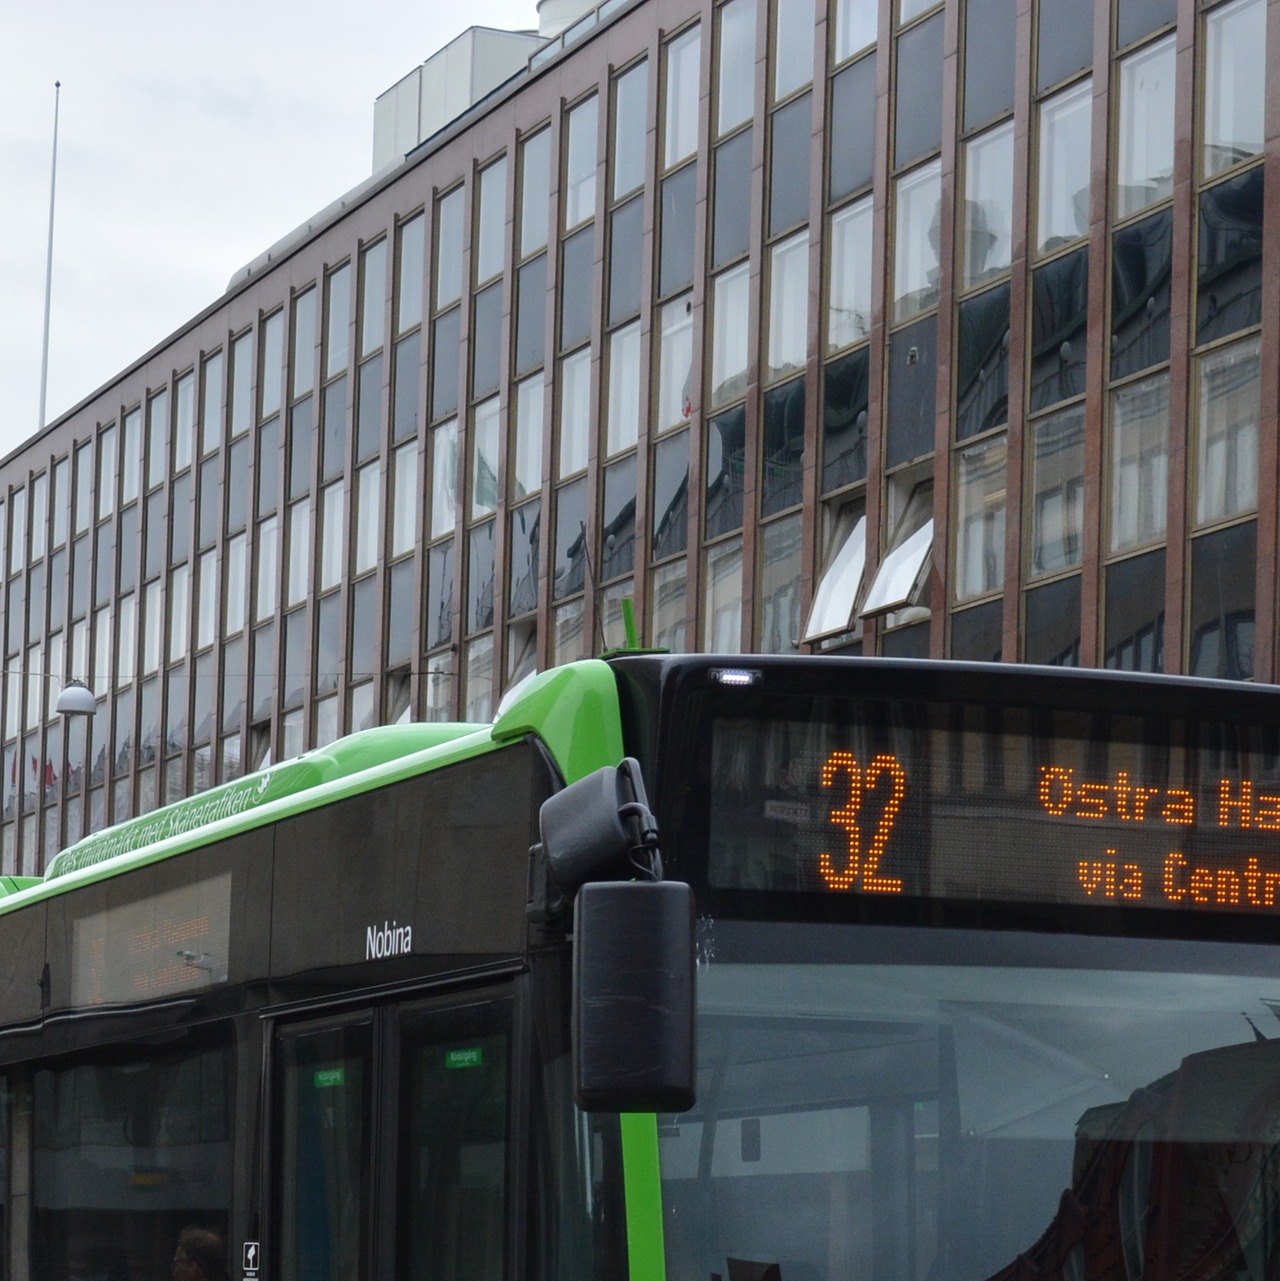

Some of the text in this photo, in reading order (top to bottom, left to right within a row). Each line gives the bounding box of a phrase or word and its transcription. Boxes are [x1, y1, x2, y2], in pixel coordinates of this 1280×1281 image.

[818, 750, 906, 895] 32
[1038, 764, 1195, 827] Östra
[1078, 848, 1144, 902] via
[366, 920, 412, 960] Nobina
